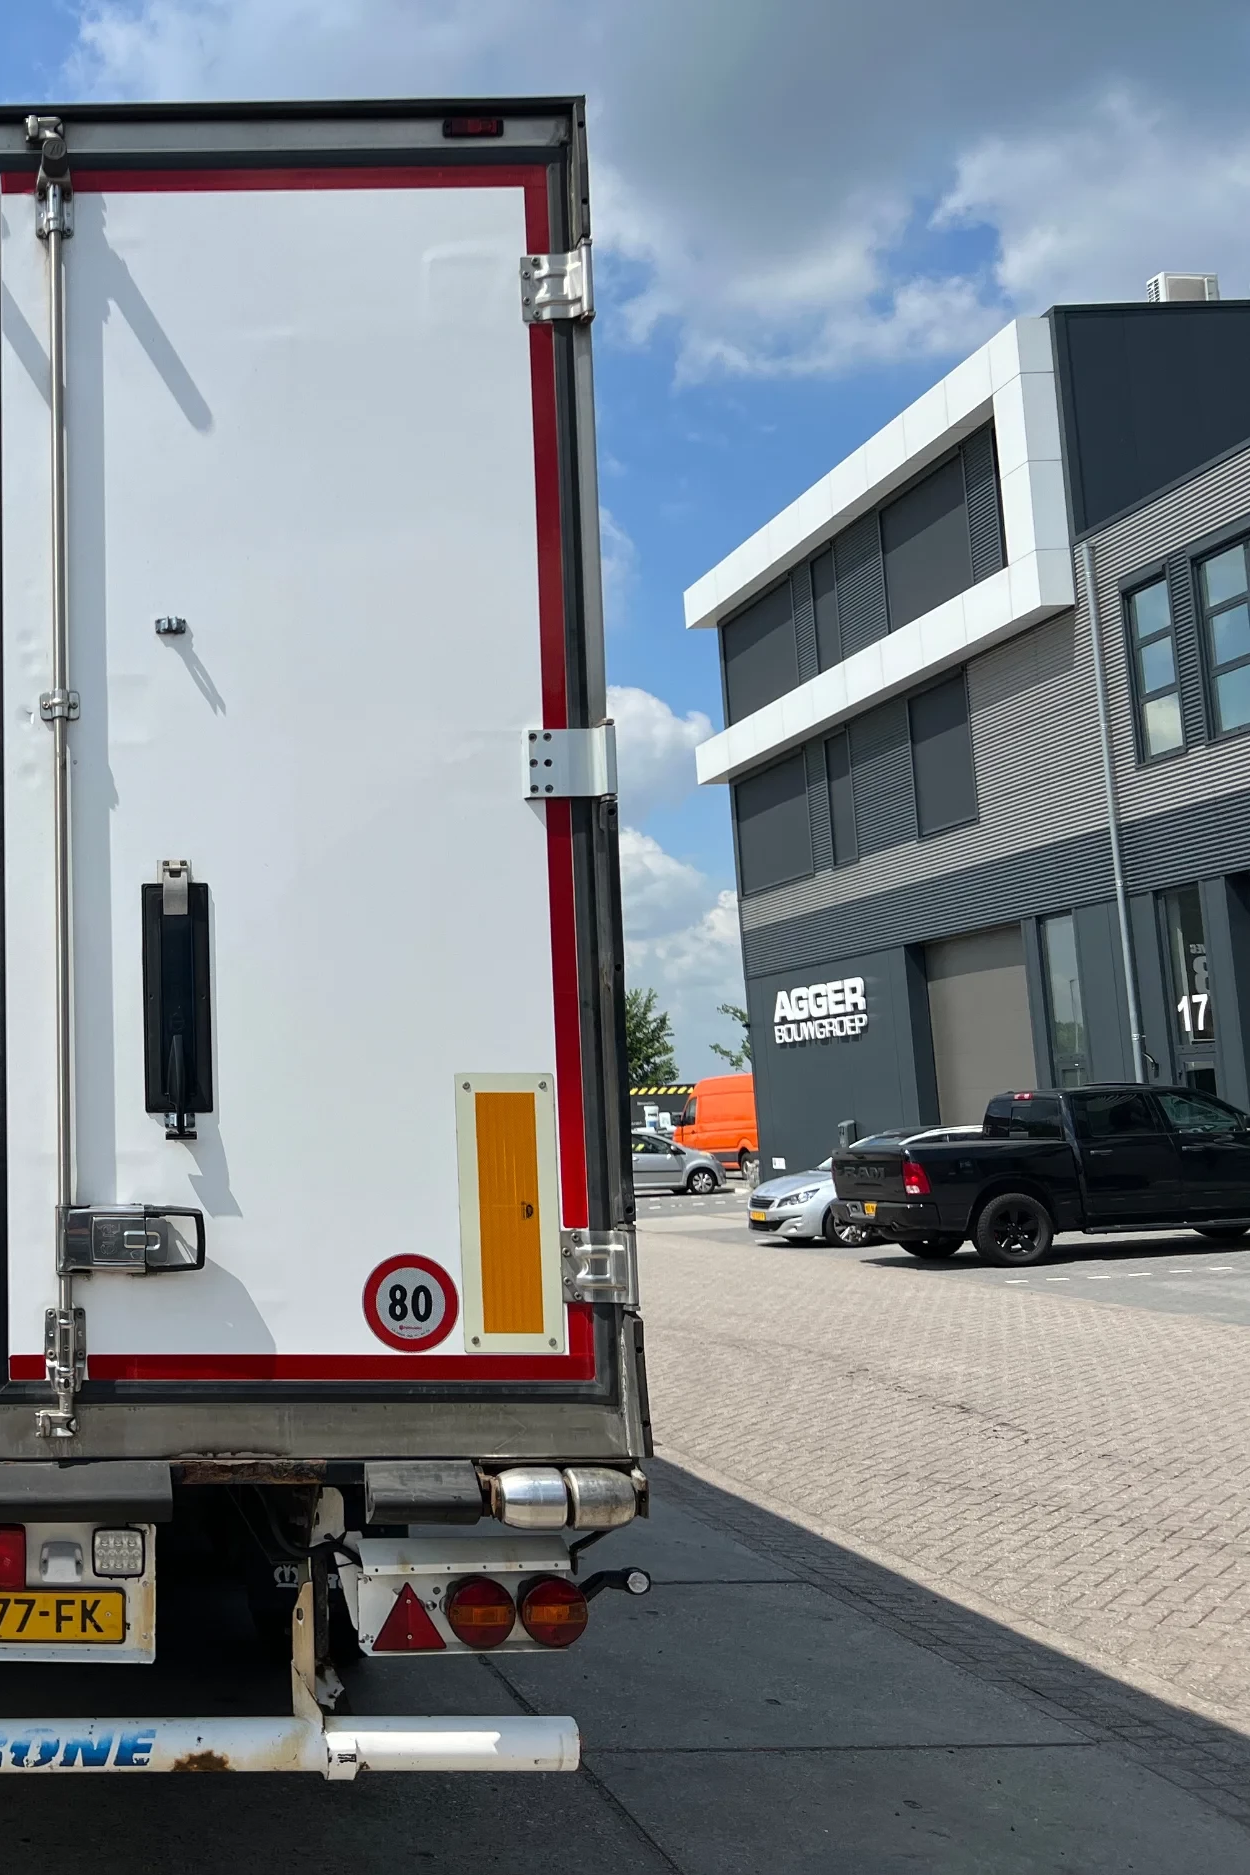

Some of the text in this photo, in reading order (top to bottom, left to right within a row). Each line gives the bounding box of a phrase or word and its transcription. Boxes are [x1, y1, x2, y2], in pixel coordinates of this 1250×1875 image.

[774, 977, 866, 1022] AGGER
[1177, 994, 1208, 1031] 17
[774, 1014, 868, 1043] BOUWGROEP
[843, 1166, 886, 1180] RAM
[389, 1284, 432, 1322] 80
